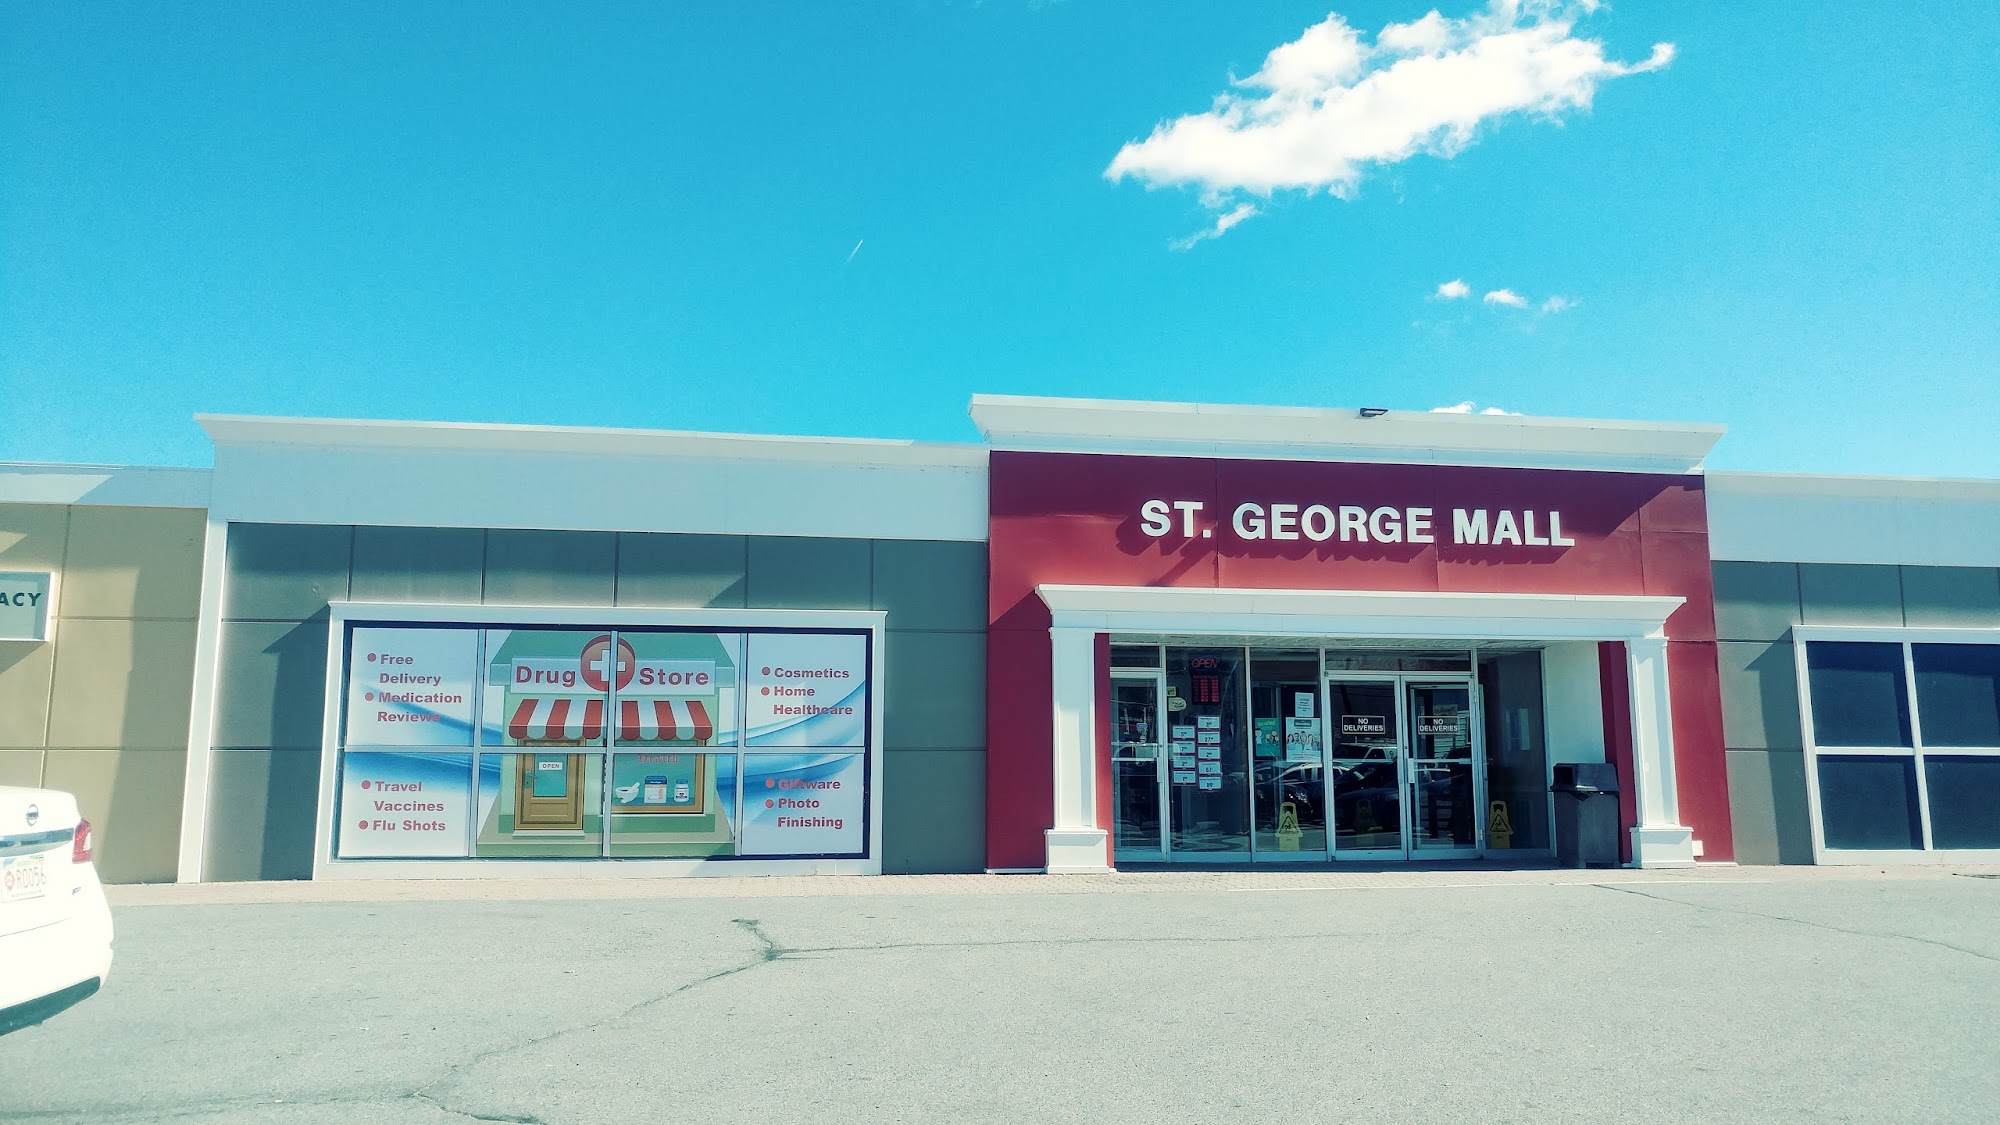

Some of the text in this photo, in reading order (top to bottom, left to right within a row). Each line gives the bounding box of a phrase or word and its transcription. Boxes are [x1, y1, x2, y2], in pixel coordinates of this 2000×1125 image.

[1140, 499, 1575, 547] ST. GEORGE MALL
[0, 592, 42, 607] ACY
[380, 654, 414, 665] Free
[1191, 658, 1218, 668] OPEN
[515, 665, 709, 688] Drug Store
[774, 667, 850, 679] Cosmetics
[379, 673, 441, 687] Delivery
[773, 686, 815, 697] Home
[378, 692, 462, 704] Medication
[773, 704, 853, 715] Healthcare
[377, 711, 441, 722] Reviews
[375, 781, 422, 792] Travel
[778, 779, 841, 790] Giftware
[374, 800, 444, 812] Vaccines
[778, 798, 820, 809] Photo
[372, 820, 446, 831] Flu Shots
[777, 816, 843, 829] Finishing
